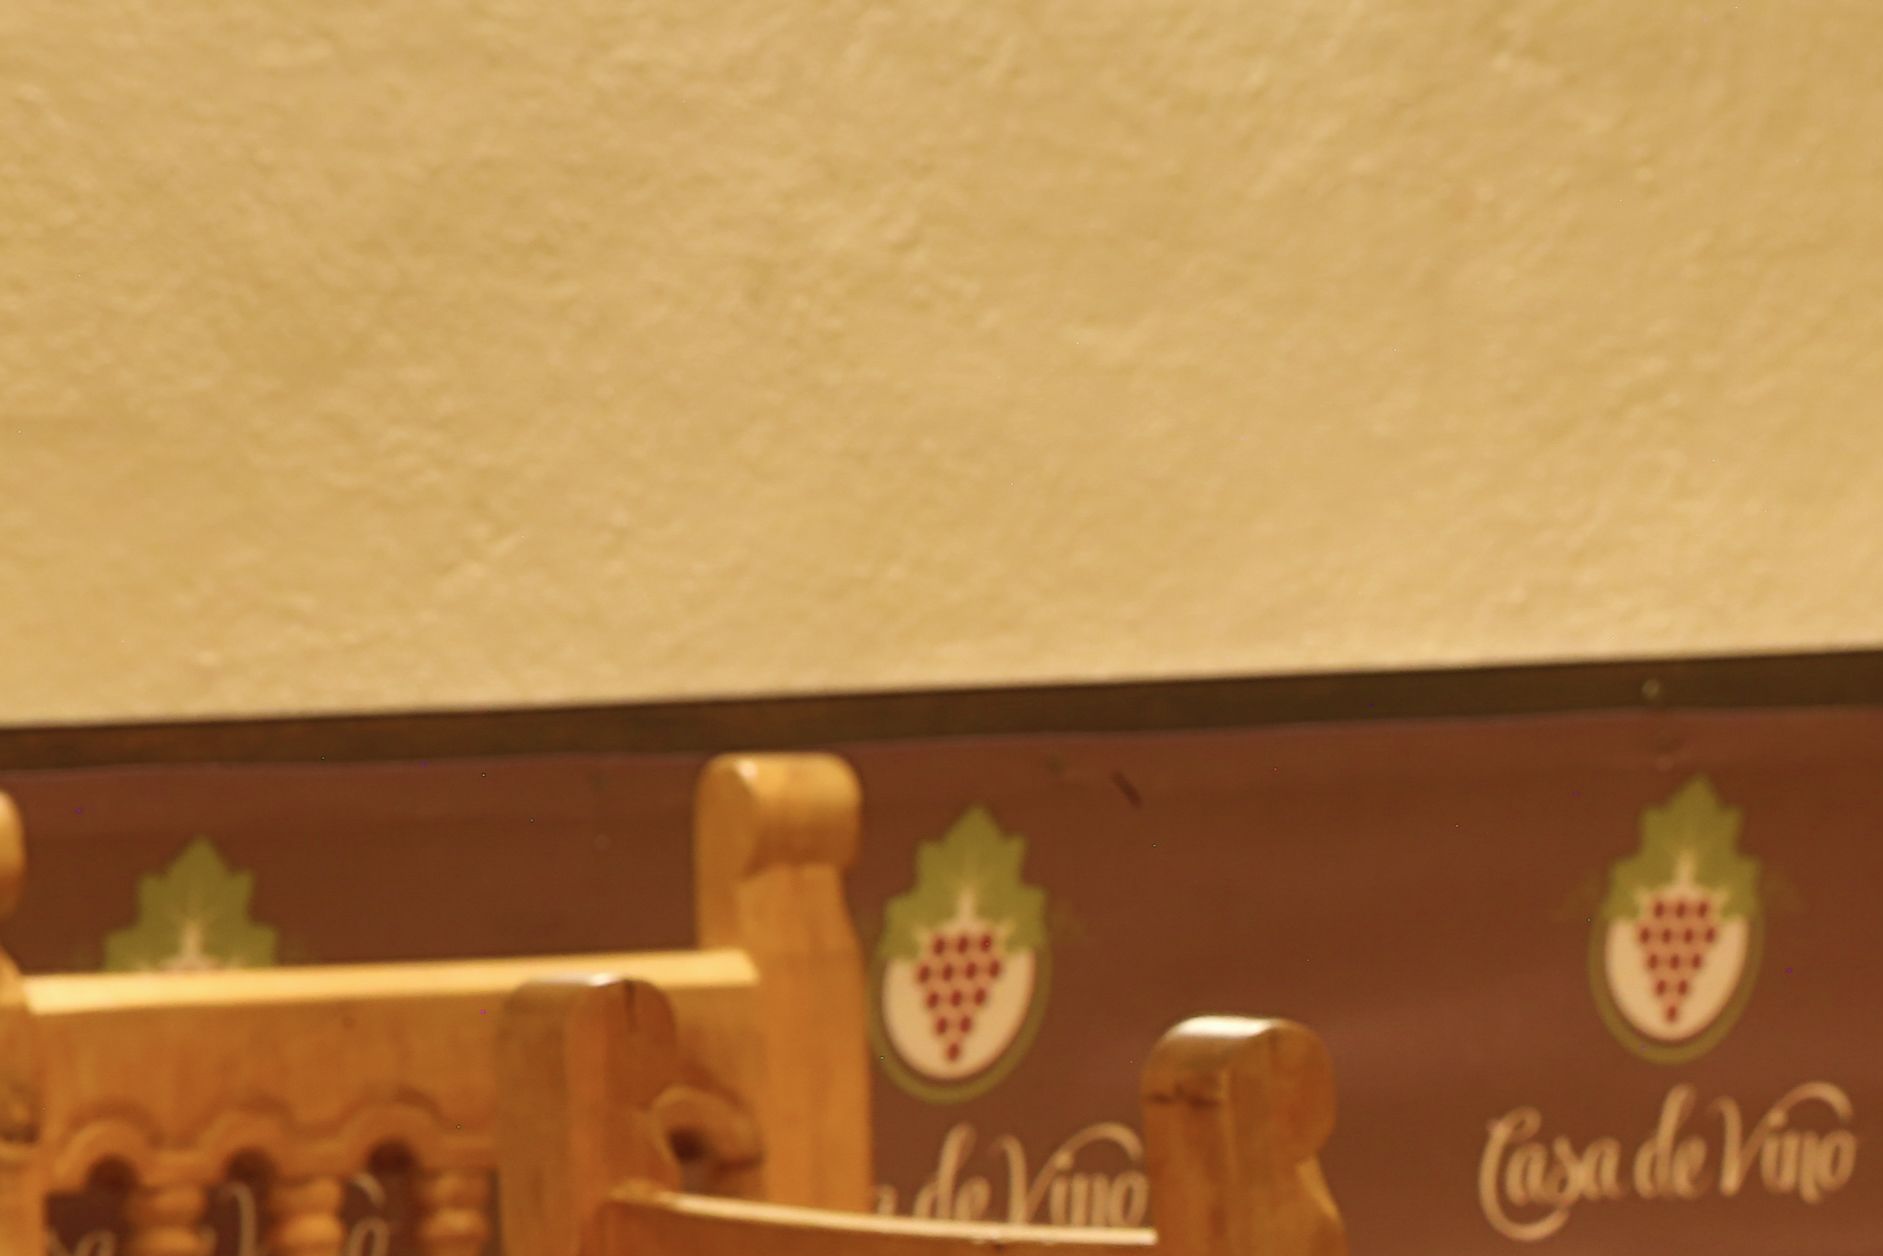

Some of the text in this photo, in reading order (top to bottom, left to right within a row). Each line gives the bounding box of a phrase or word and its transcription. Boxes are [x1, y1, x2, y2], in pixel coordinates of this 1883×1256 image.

[991, 1120, 1150, 1229] Vino
[1478, 1080, 1859, 1242] Casa de Vino
